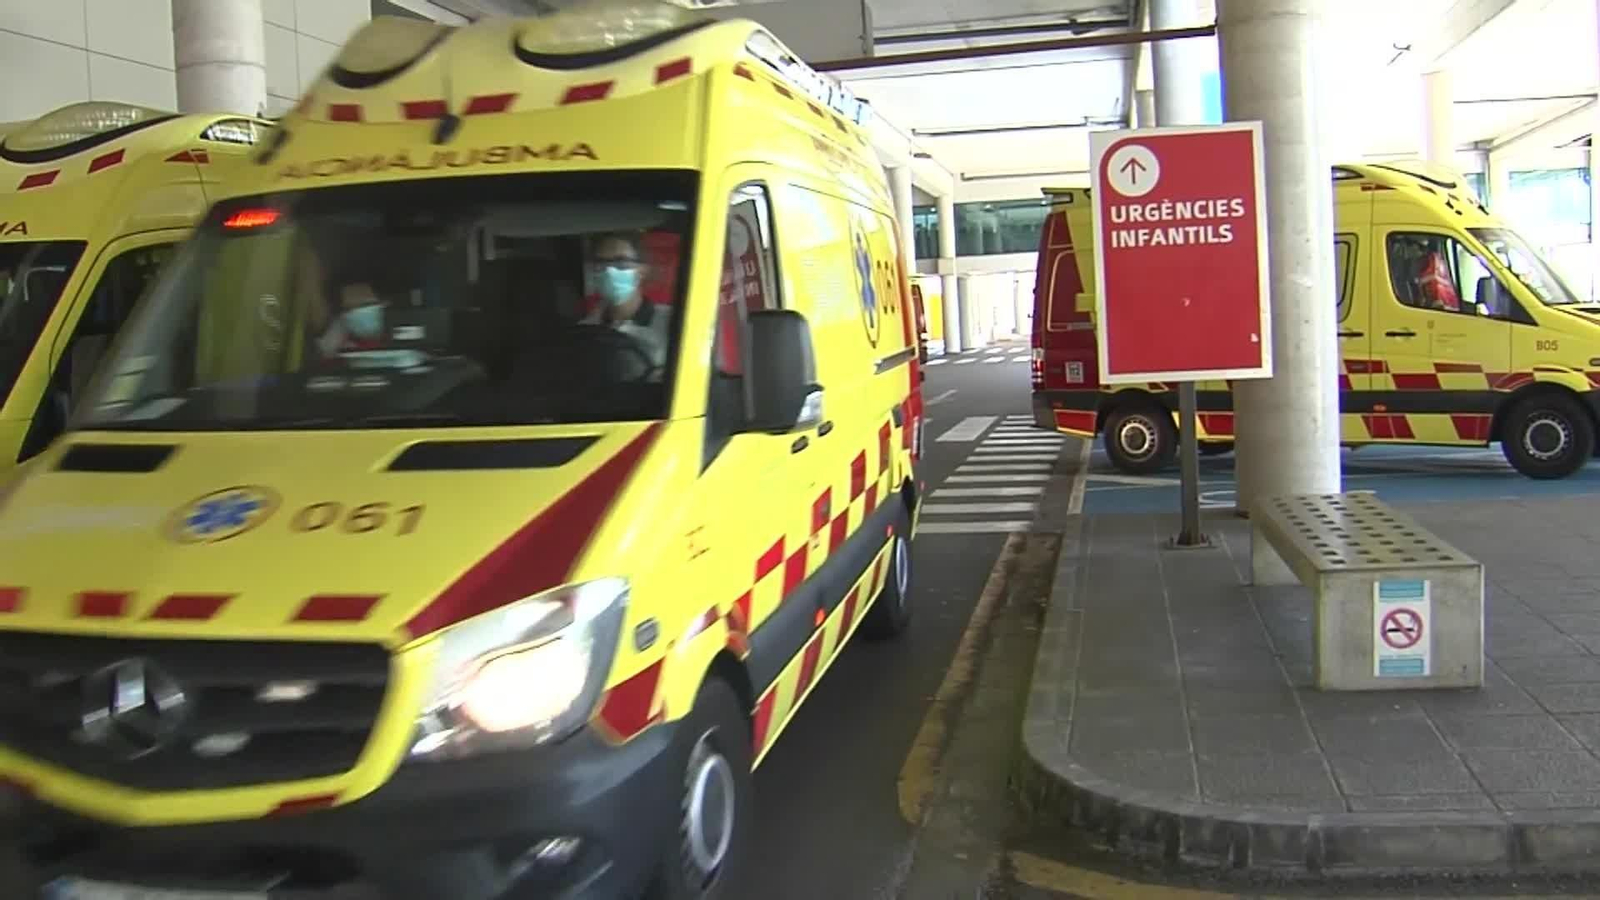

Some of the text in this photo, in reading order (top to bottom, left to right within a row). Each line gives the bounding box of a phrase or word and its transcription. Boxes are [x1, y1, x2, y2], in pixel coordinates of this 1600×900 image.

[1110, 199, 1245, 223] URGÈNCIES
[1111, 225, 1233, 248] INFANTILS
[1536, 340, 1558, 351] B05
[289, 501, 427, 536] 061
